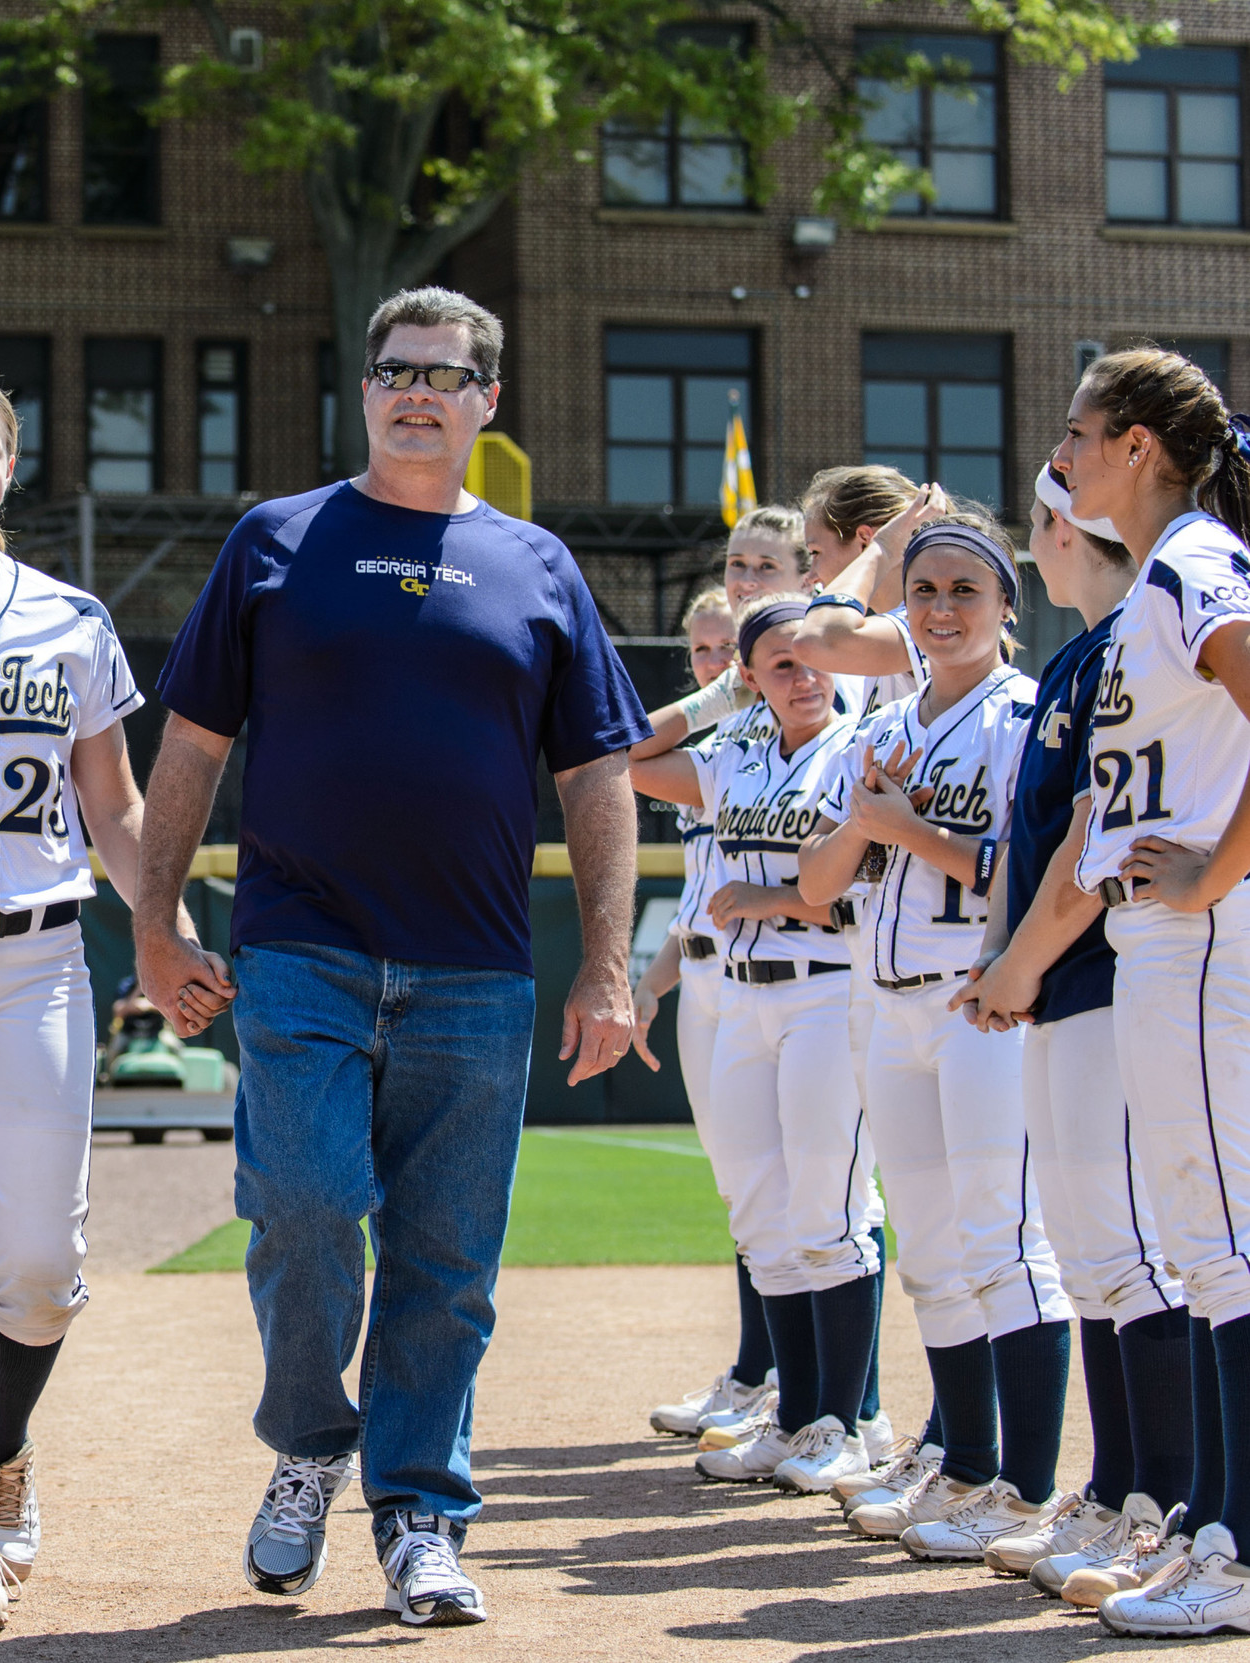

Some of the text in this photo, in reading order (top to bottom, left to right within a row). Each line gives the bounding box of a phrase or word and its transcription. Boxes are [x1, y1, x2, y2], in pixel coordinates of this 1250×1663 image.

[355, 560, 427, 578] GEORGIA
[1, 654, 70, 724] Tech
[1093, 738, 1173, 833] 21
